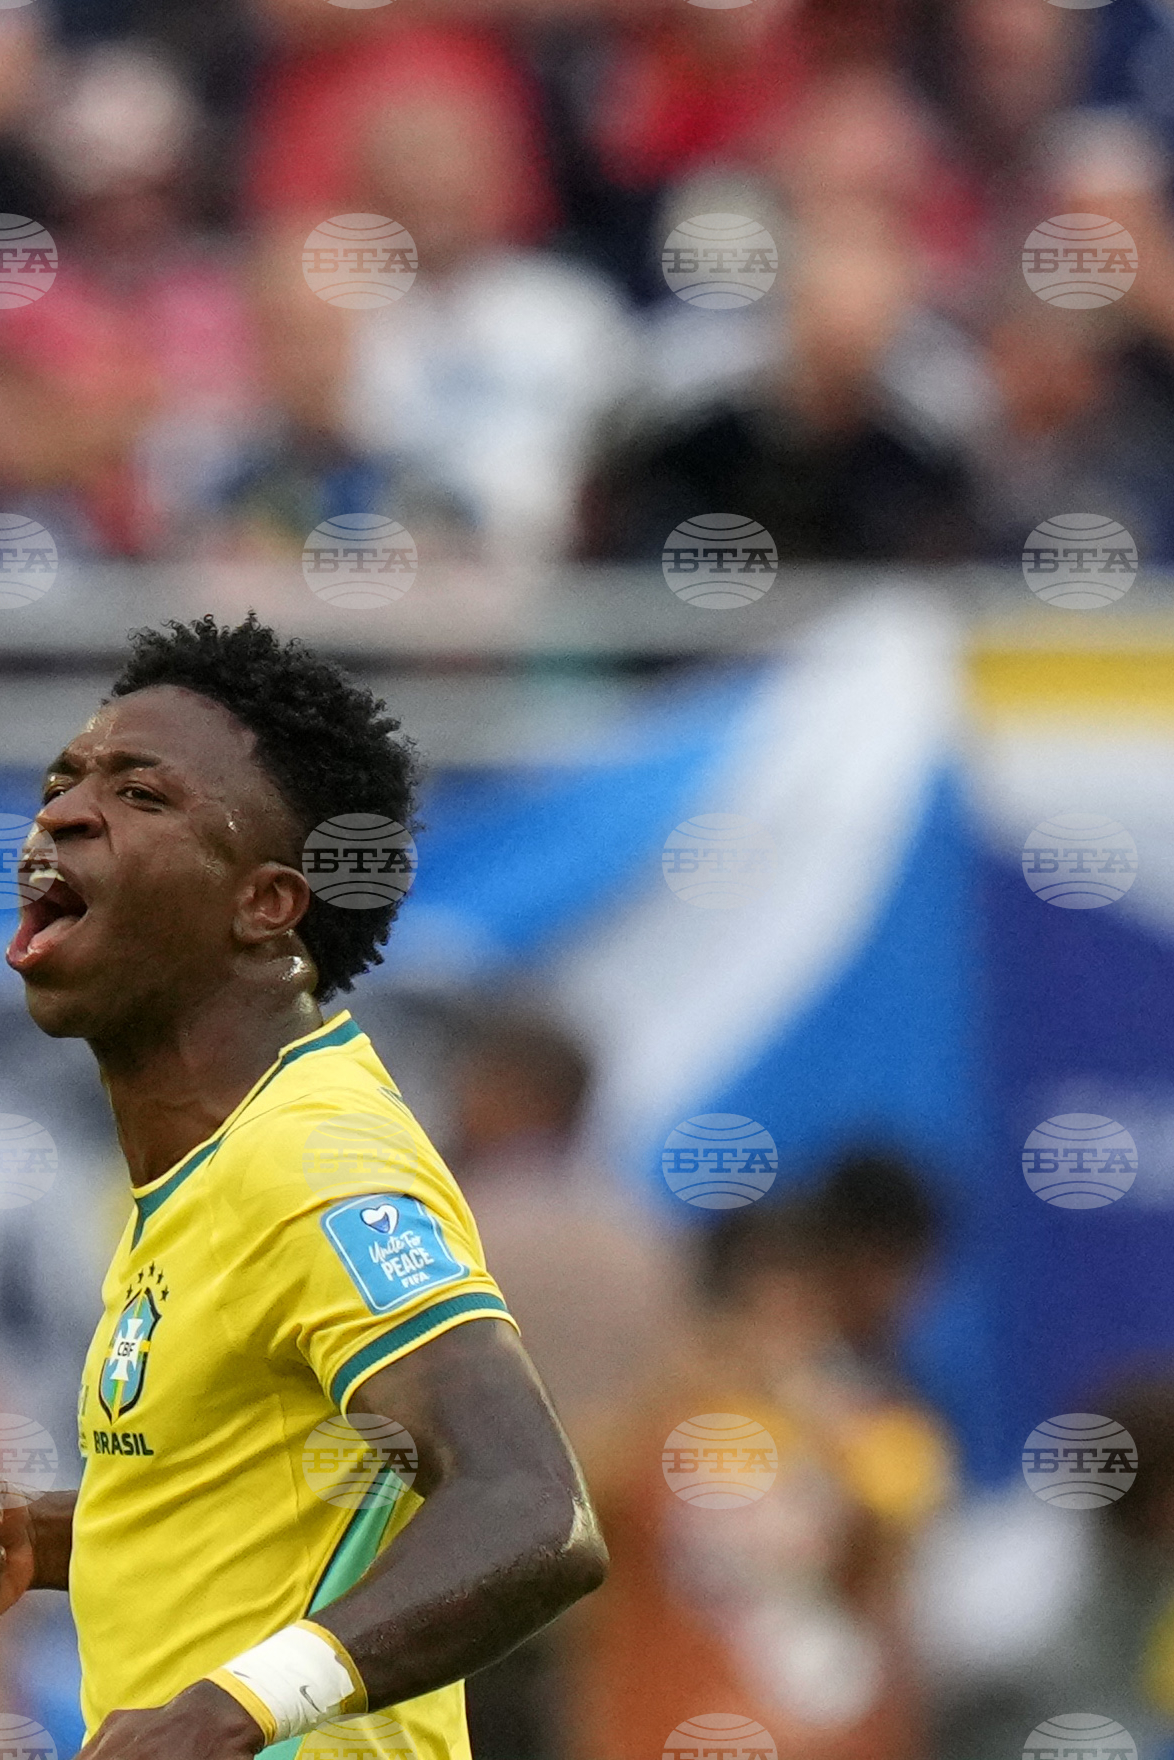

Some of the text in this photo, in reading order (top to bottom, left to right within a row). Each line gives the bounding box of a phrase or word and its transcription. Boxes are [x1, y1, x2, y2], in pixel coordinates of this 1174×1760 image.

[380, 1246, 435, 1282] PEACE
[400, 1271, 431, 1288] FIFA
[117, 1341, 136, 1357] CBF
[93, 1430, 155, 1456] BRASIL
